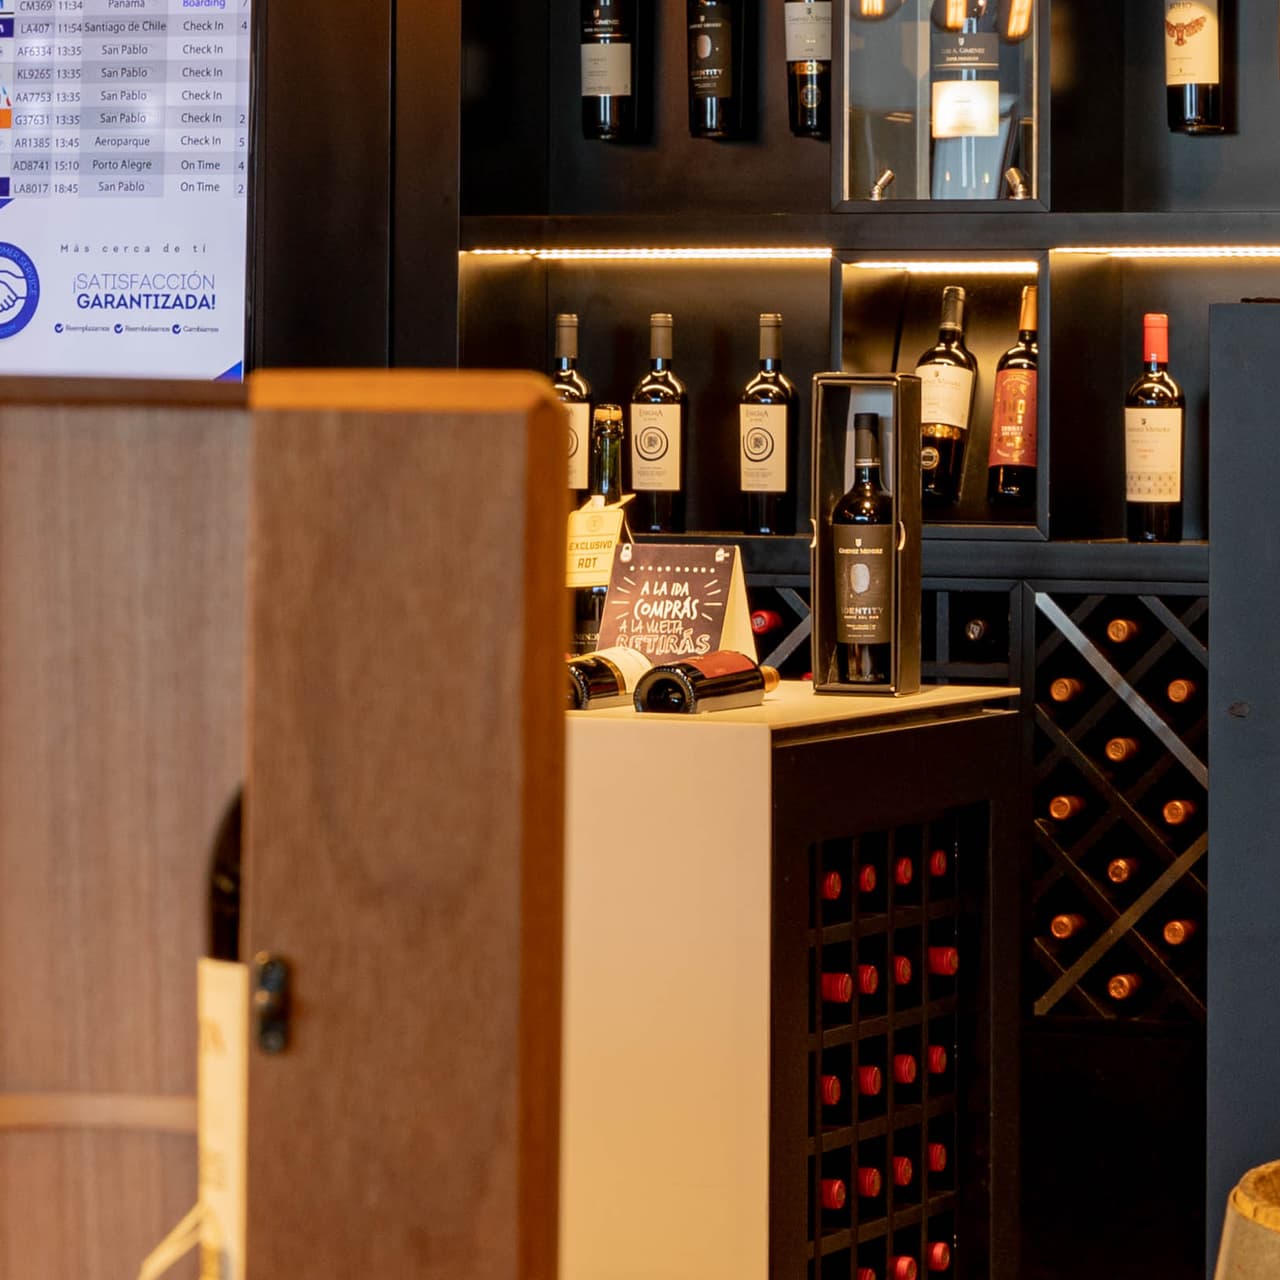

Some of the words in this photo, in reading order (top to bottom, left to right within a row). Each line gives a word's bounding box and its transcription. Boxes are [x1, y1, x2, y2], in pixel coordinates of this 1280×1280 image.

[19, 1, 52, 11] CM369
[59, 0, 83, 11] 11:34
[21, 23, 50, 34] LA407
[58, 23, 82, 33] 11:54
[84, 22, 126, 34] Santiago
[128, 21, 140, 31] de
[142, 21, 167, 31] Chile
[183, 20, 212, 31] Check
[214, 21, 224, 31] In
[15, 92, 52, 102] AA7753
[56, 92, 81, 102] 13:35
[94, 136, 151, 149] Aeroparque
[13, 160, 49, 171] AD8741
[55, 160, 80, 171] 15:10
[92, 159, 119, 170] Porto
[120, 159, 153, 172] Alegre
[180, 160, 196, 170] On
[197, 160, 221, 170] Time
[13, 183, 49, 194] LA8017
[54, 183, 79, 194] 18:45
[98, 181, 116, 192] San
[117, 181, 145, 192] Pablo
[60, 243, 90, 253] Más
[102, 244, 151, 253] cerca
[163, 243, 181, 253] de
[73, 270, 216, 293] ¡SATISFACCIÓN
[76, 293, 216, 310] GARANTIZADA!
[640, 580, 649, 596] A
[653, 581, 667, 596] LA
[671, 581, 690, 596] IDA
[634, 596, 700, 621] COMPRÁS
[619, 619, 627, 633] A
[631, 619, 643, 634] LA
[646, 619, 684, 635] VUELTA
